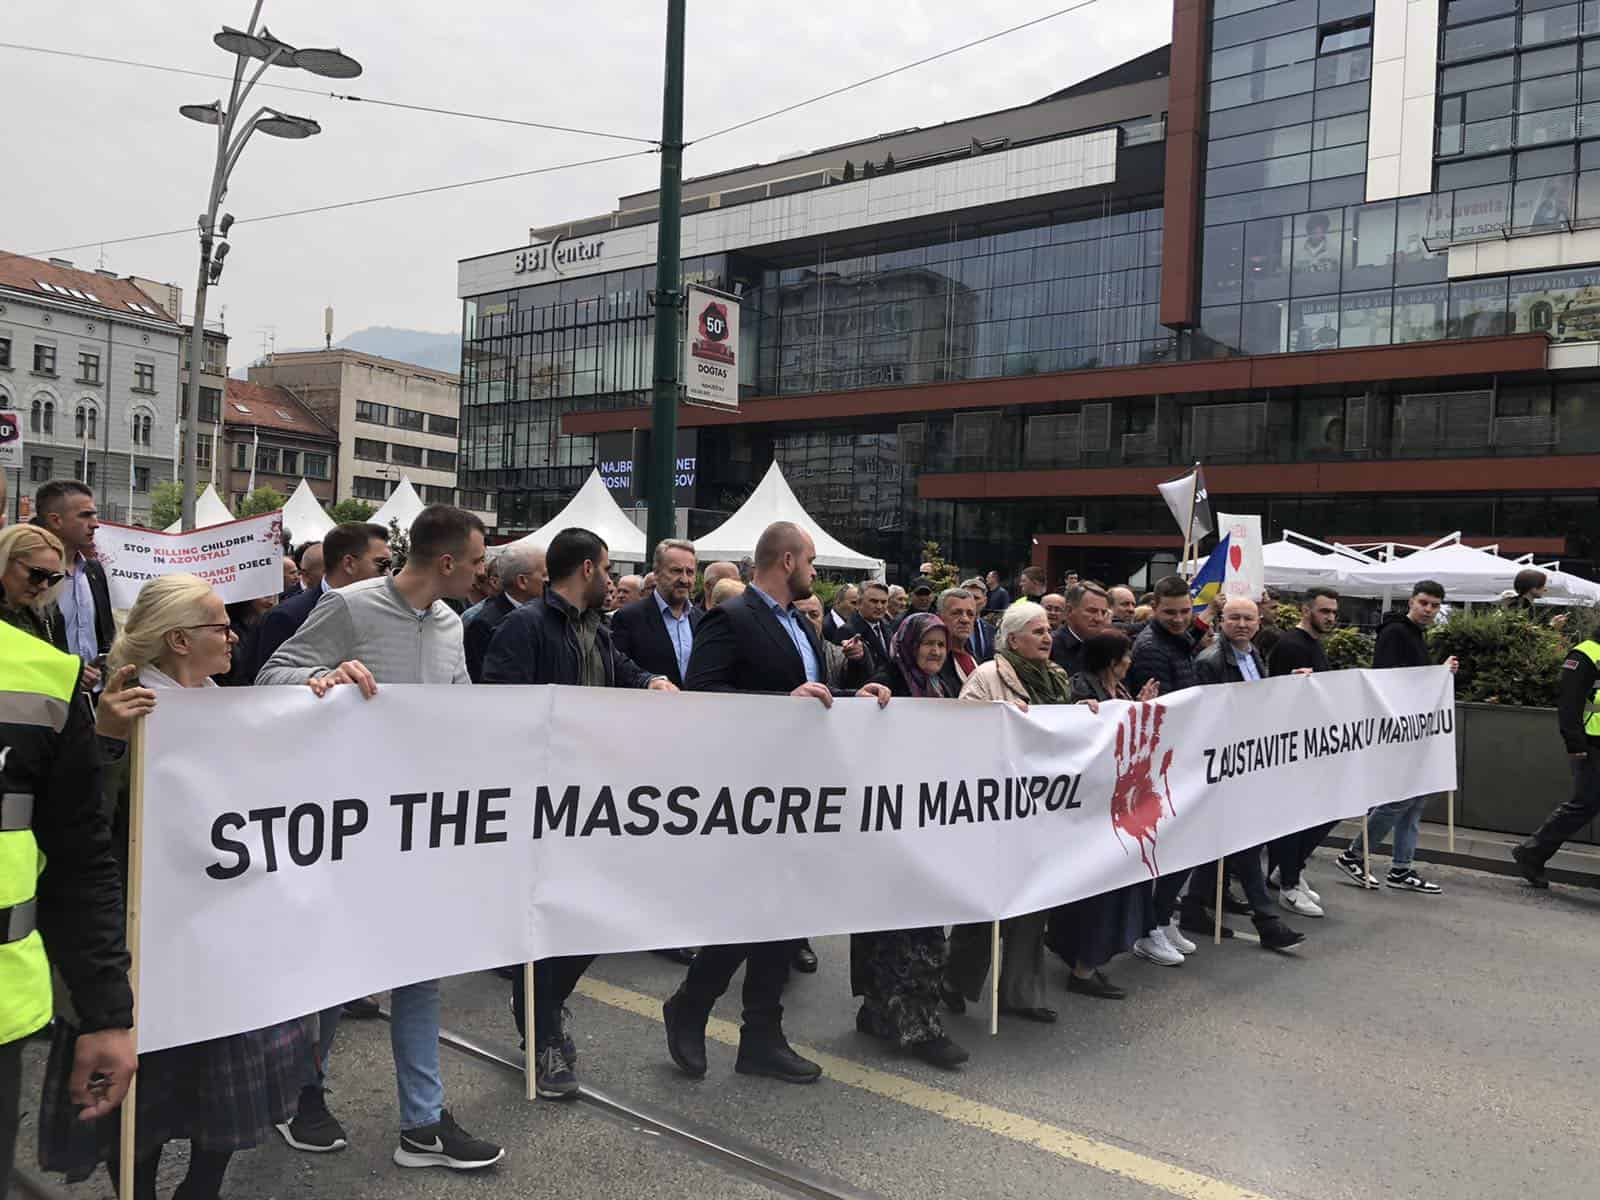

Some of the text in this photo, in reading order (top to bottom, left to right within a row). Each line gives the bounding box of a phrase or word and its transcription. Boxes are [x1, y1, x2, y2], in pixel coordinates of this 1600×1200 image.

[513, 246, 549, 274] BBI
[600, 458, 697, 473] NAJBR NET
[124, 534, 254, 556] STOP KILLING CHILDREN
[153, 556, 165, 564] IN
[238, 557, 272, 571] DJECE
[1203, 730, 1299, 785] ZAUSTAVITE
[205, 773, 1082, 880] STOP THE MASSACRE IN MARIUPOL
